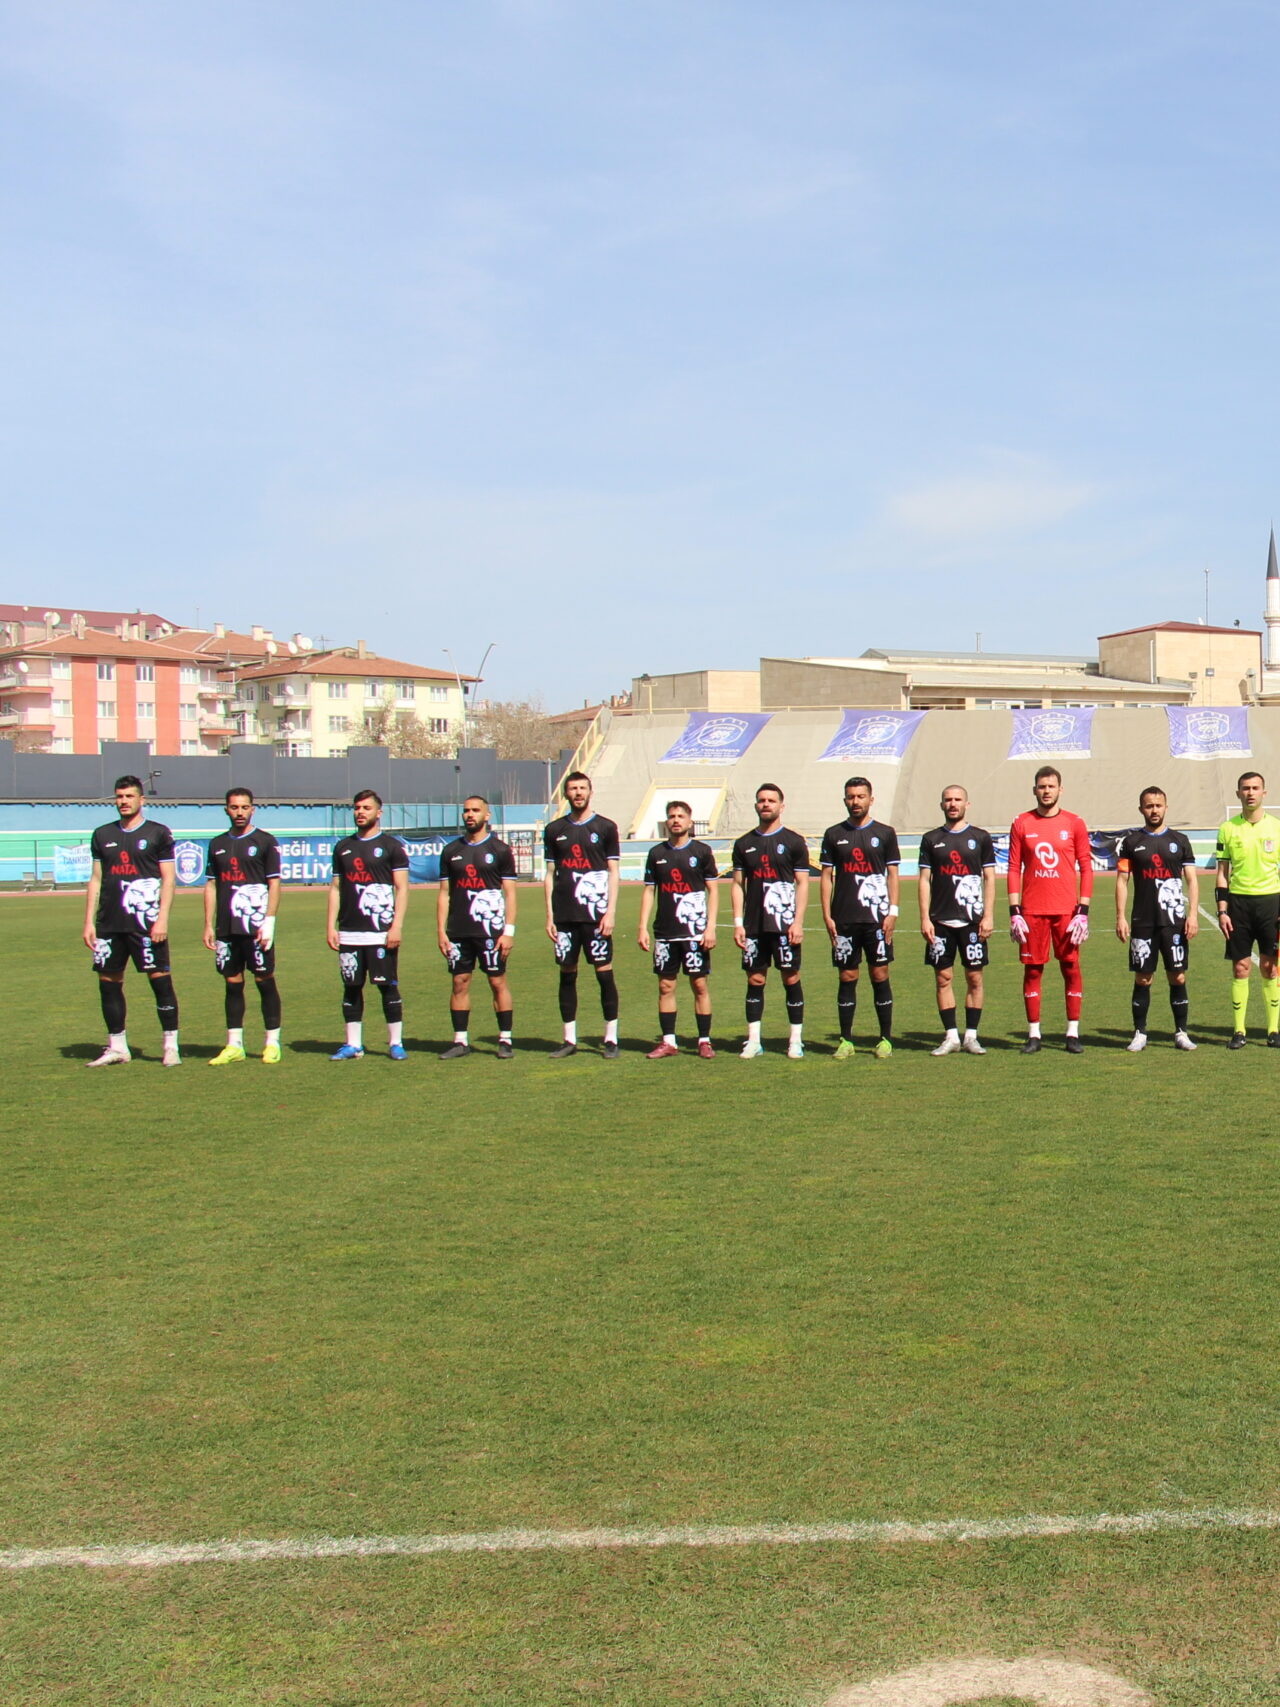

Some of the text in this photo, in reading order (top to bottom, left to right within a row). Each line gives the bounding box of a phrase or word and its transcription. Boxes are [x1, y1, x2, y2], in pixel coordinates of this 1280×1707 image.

[277, 840, 314, 857] EĞİL
[111, 864, 138, 875] NATA
[280, 858, 333, 879] GELİY
[562, 858, 592, 869] NATA
[843, 862, 873, 873] NATA
[940, 864, 971, 876] NATA
[345, 872, 373, 883] NATA
[1034, 869, 1060, 879] NATA
[1142, 868, 1172, 880] NATA
[456, 878, 486, 889] NATA
[661, 882, 692, 893] NATA
[590, 940, 608, 956] 22
[778, 946, 793, 962] 13
[876, 940, 886, 957] 4
[966, 943, 983, 960] 66
[1170, 945, 1185, 962] 10
[144, 948, 154, 964] 5
[254, 950, 264, 966] 9
[685, 952, 703, 967] 26
